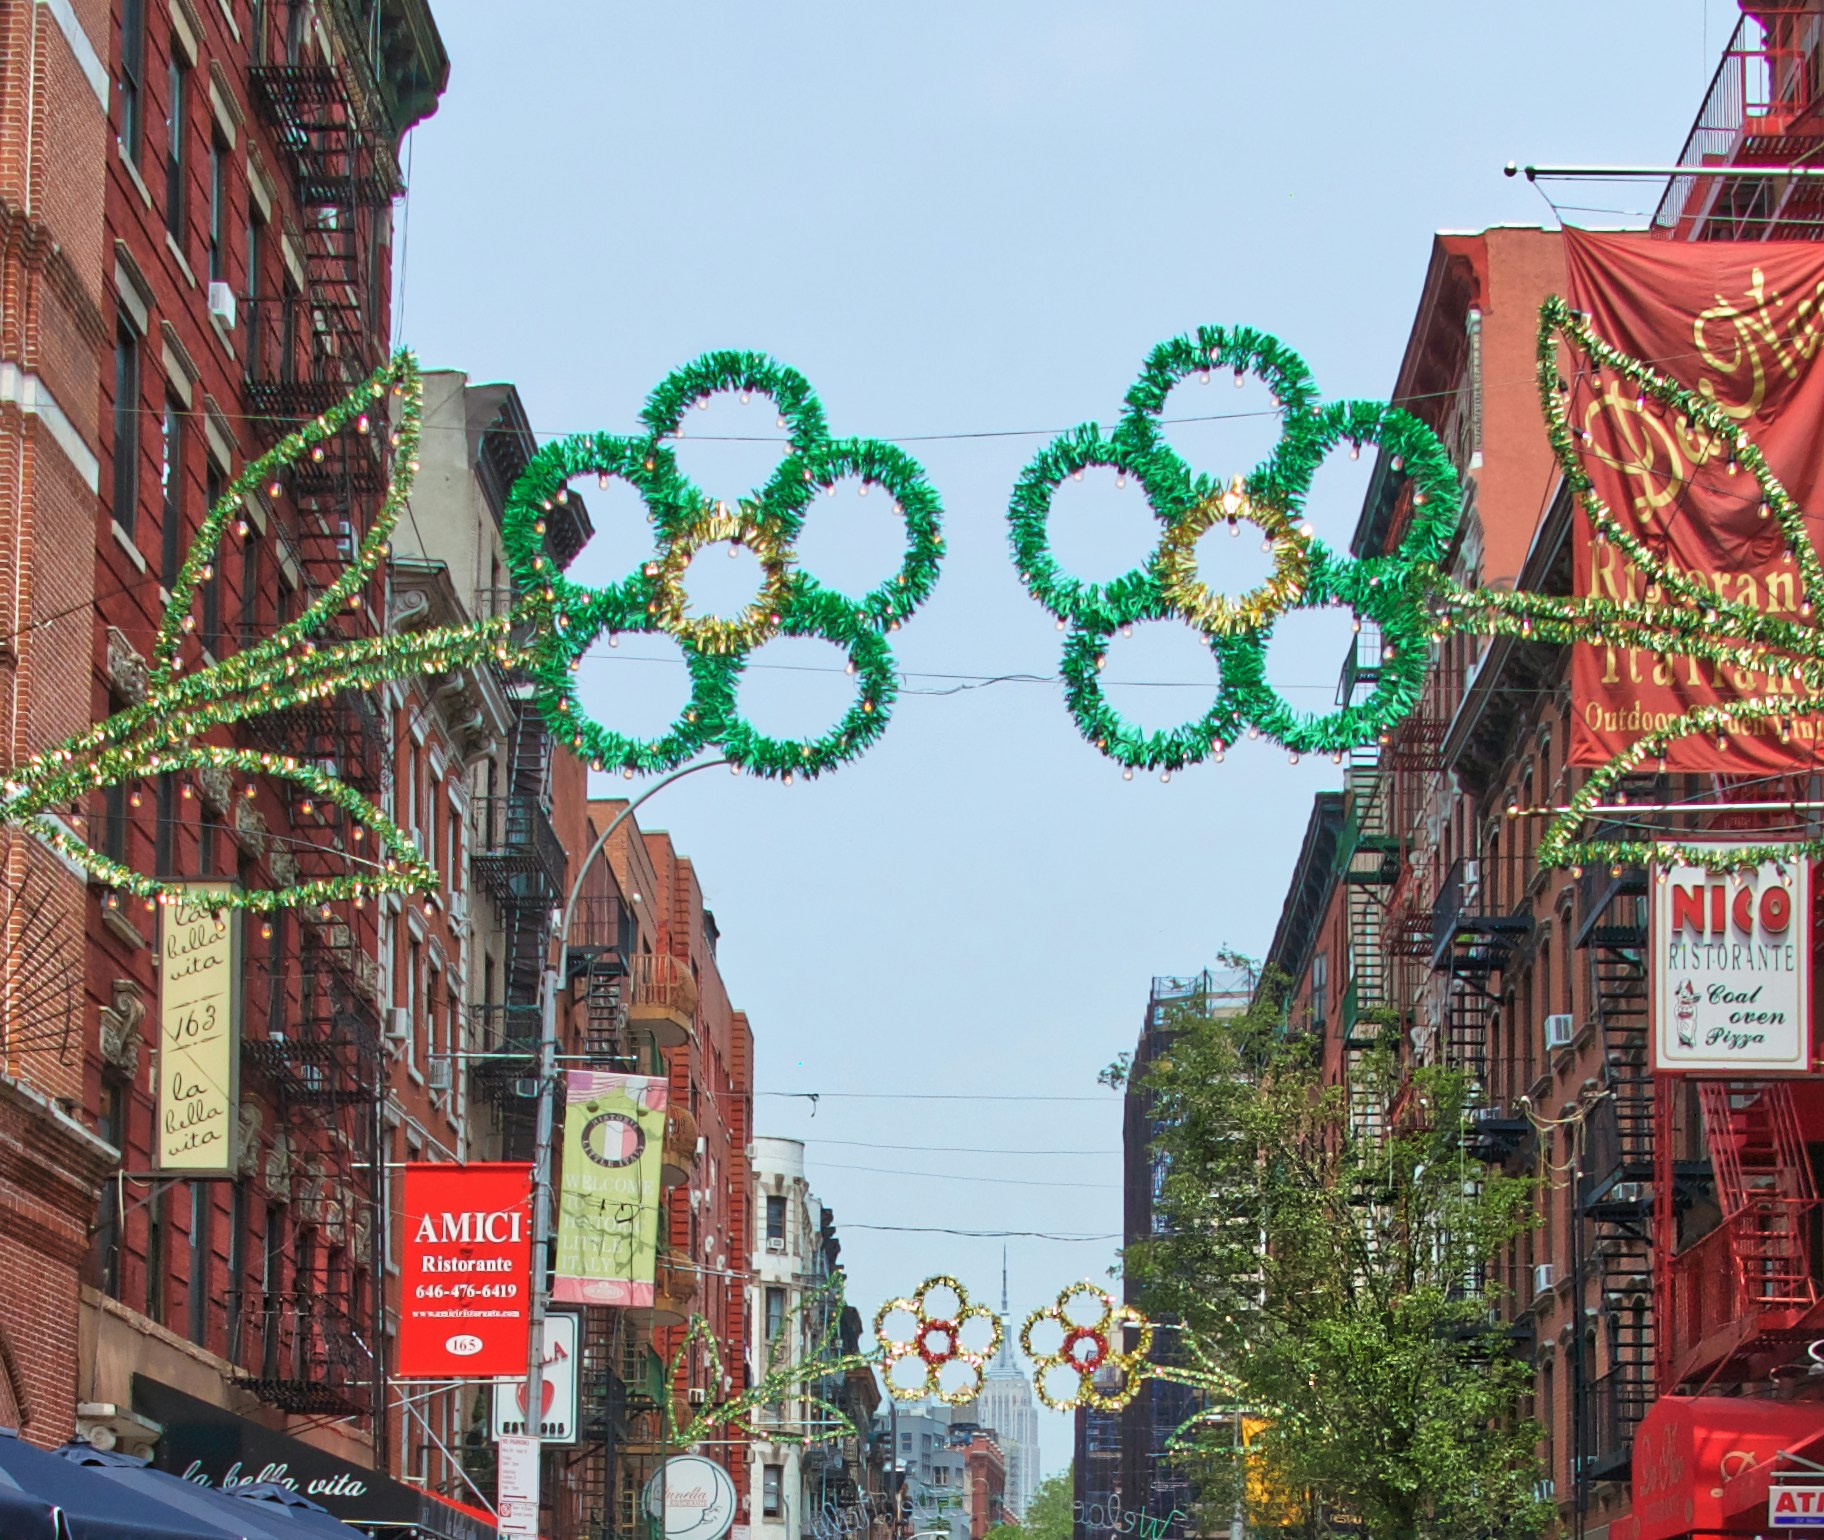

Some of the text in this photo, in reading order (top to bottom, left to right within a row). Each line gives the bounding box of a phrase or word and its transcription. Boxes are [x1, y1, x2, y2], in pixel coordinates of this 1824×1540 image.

[1672, 884, 1791, 934] NICO
[167, 924, 225, 961] bella
[169, 955, 224, 981] vita
[1669, 943, 1795, 972] RISTORANTE
[1706, 983, 1763, 1005] Coal
[173, 1004, 217, 1042] 163
[1729, 1011, 1786, 1025] oven
[1705, 1027, 1766, 1049] Pizza
[172, 1072, 207, 1101] la
[165, 1098, 224, 1135] bella
[168, 1130, 222, 1156] vita
[565, 1173, 654, 1195] WELCOME
[414, 1211, 523, 1243] AMICI
[421, 1255, 512, 1272] Ristorante
[415, 1284, 517, 1299] 646-476-6419
[453, 1339, 476, 1351] 165
[222, 1461, 299, 1493] bella
[306, 1473, 368, 1497] vita
